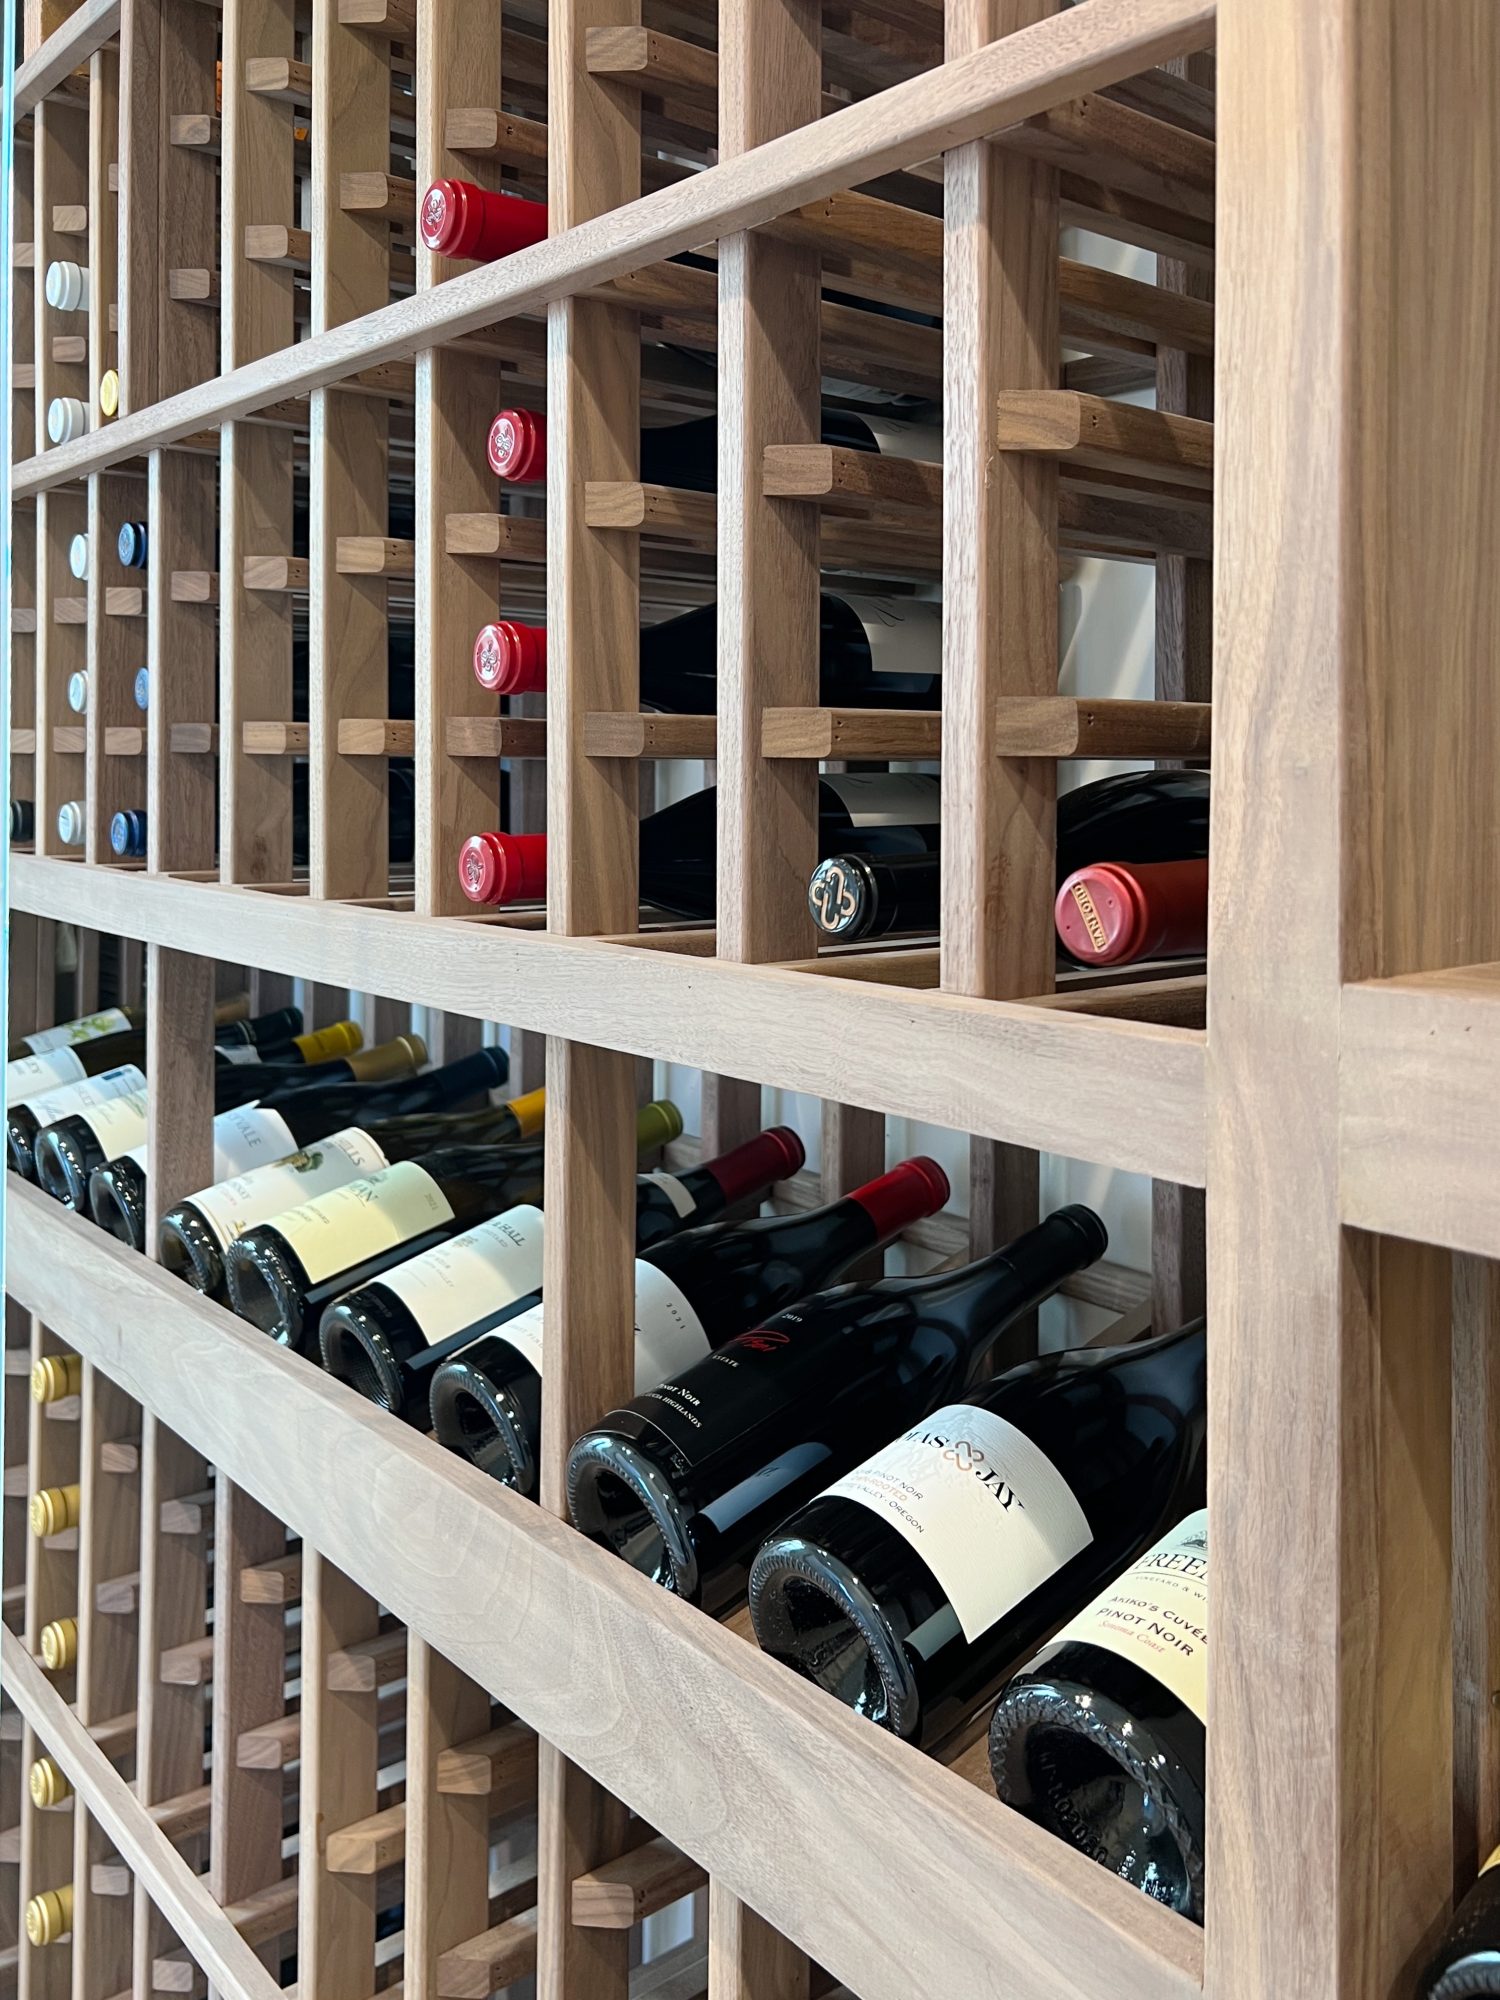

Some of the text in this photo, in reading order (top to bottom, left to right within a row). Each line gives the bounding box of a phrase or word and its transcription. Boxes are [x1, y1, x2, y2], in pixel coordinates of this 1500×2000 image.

[498, 1223, 527, 1247] HALL
[666, 1303, 686, 1330] 2021
[781, 1312, 803, 1323] 2019
[677, 1388, 702, 1408] NOIR
[662, 1395, 703, 1429] HIGHLANDS
[899, 1481, 924, 1501] NOIR
[975, 1467, 1025, 1513] JAY
[888, 1500, 925, 1534] OREGON
[1134, 1553, 1208, 1580] FREE
[1135, 1575, 1208, 1602] VINEYARD & WI
[1110, 1595, 1158, 1612] AKIKO'S
[1096, 1607, 1195, 1656] PINOT NOIR
[1098, 1620, 1166, 1653] Sonoma Coast
